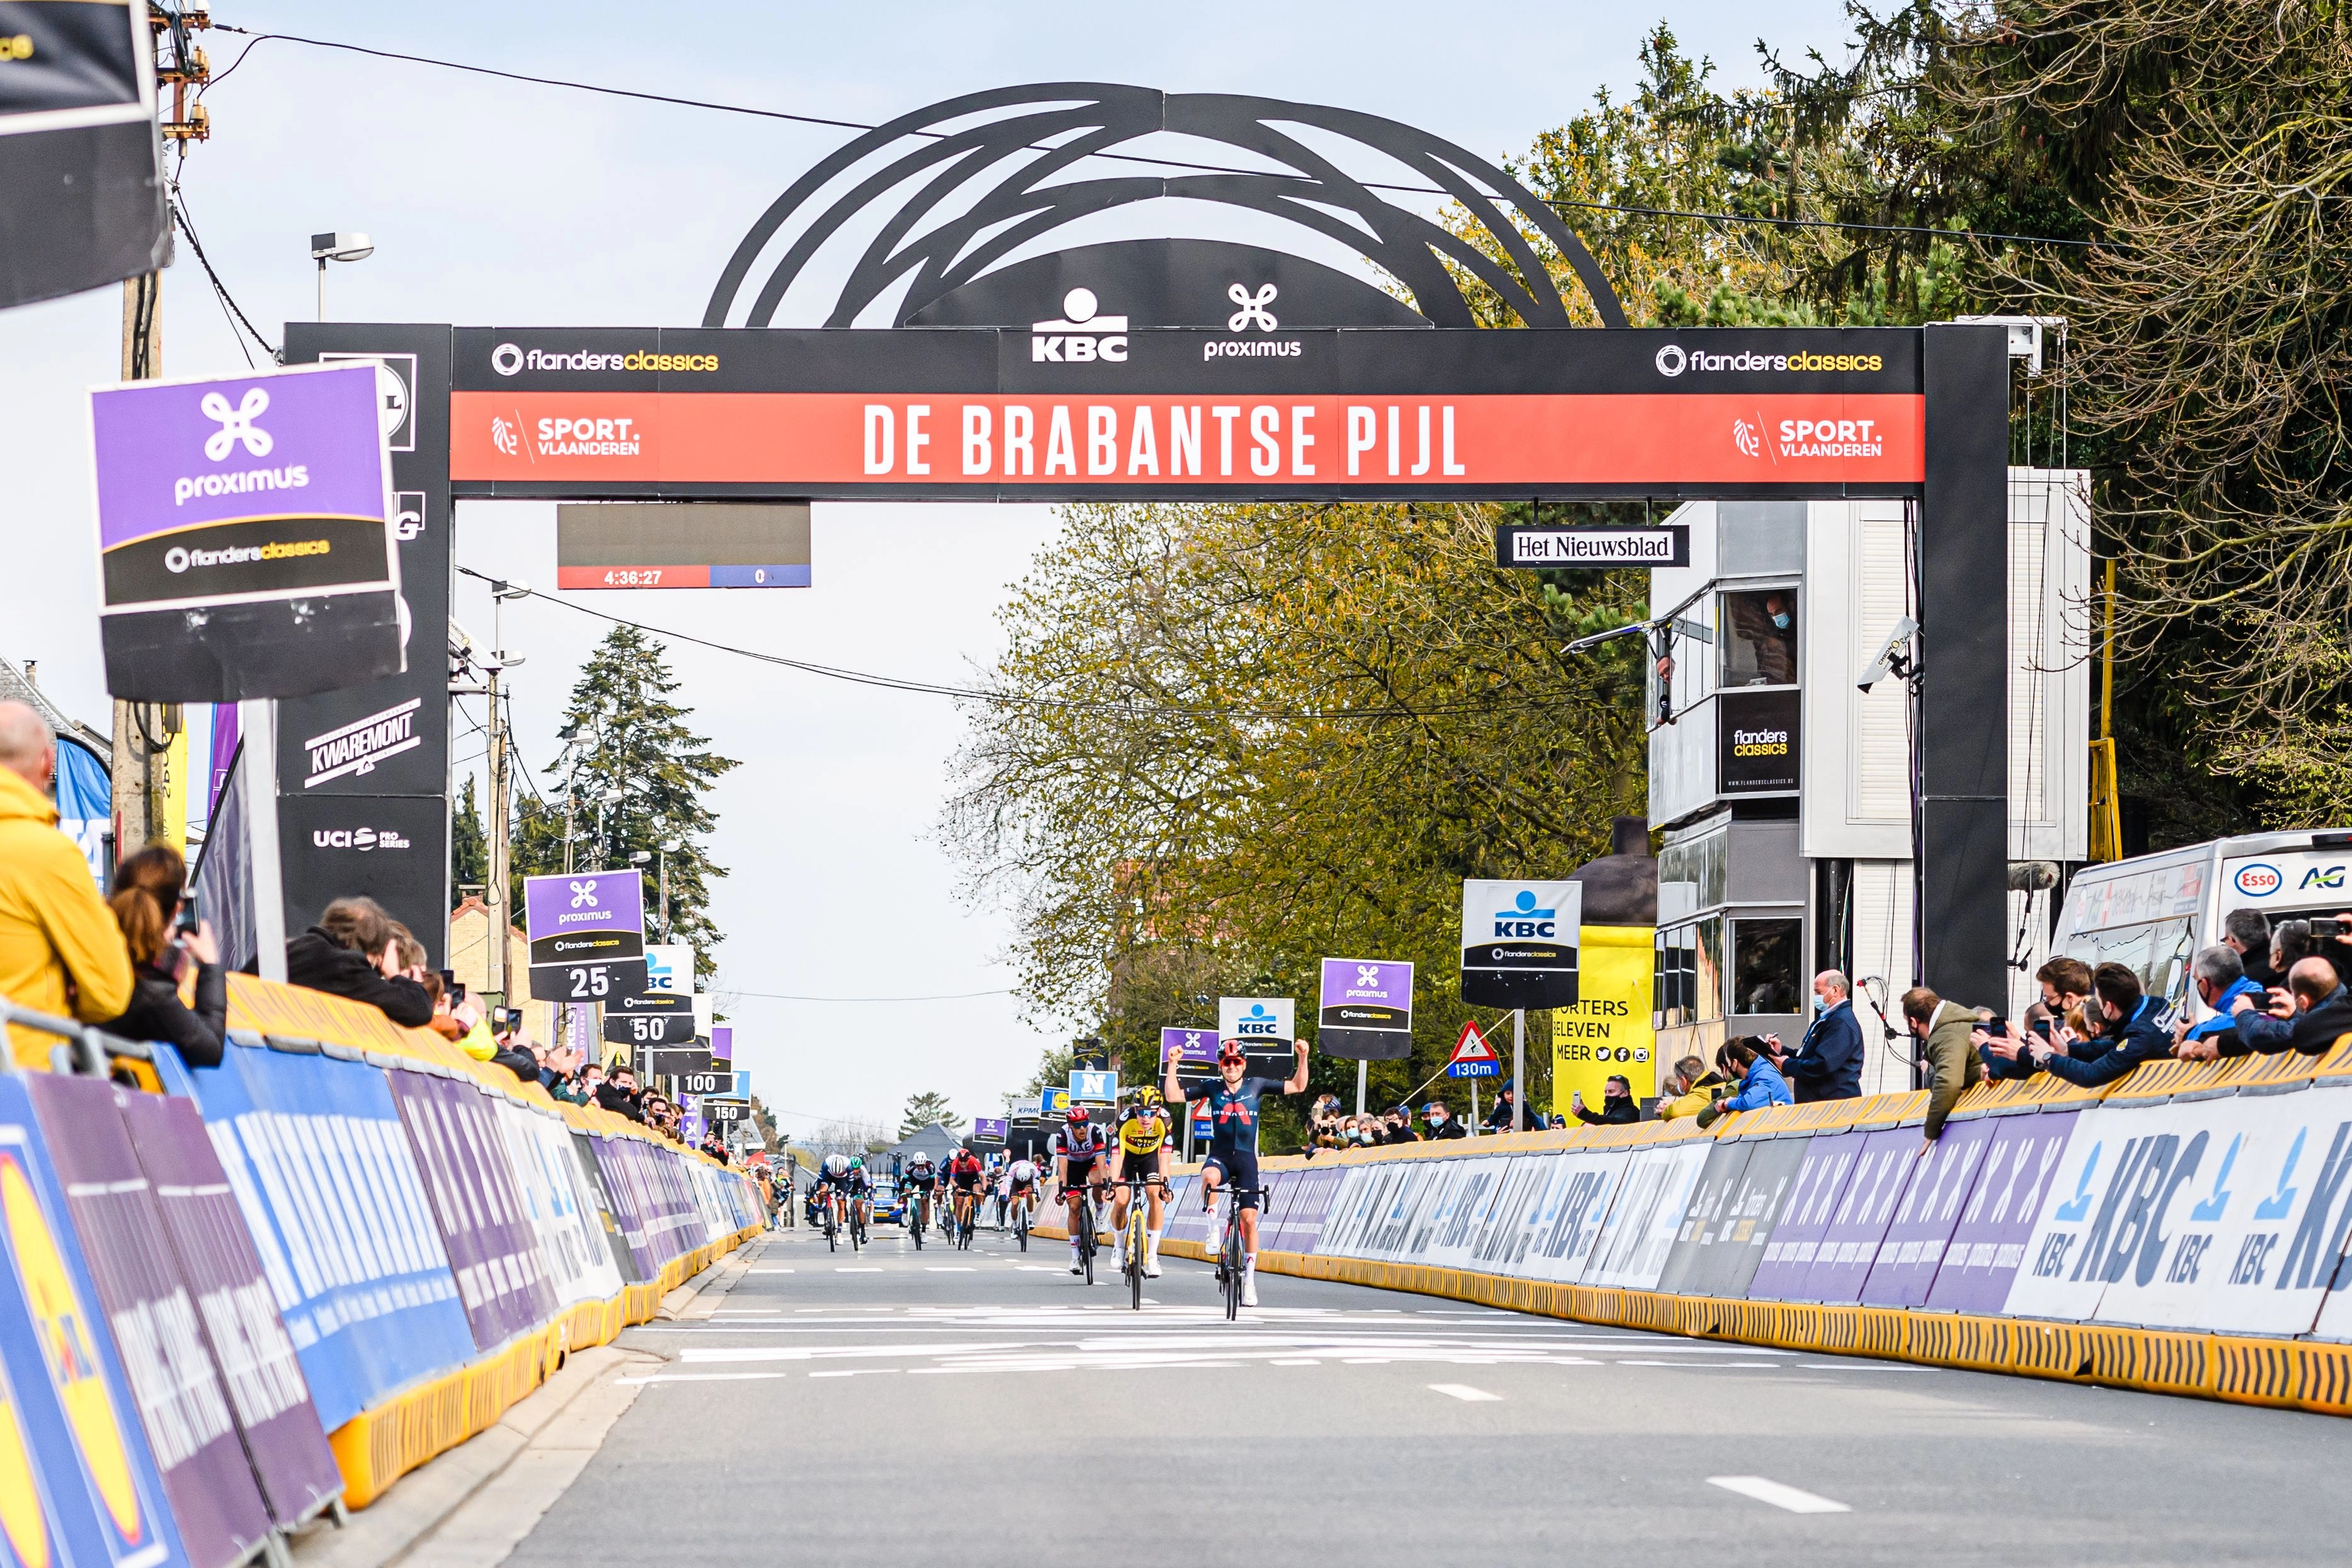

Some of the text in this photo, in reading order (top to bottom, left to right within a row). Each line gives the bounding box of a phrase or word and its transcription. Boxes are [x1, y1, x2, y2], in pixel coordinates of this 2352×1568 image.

[1031, 336, 1128, 362] KBC
[1203, 341, 1302, 362] proximus
[537, 418, 640, 441] SPORT.
[1779, 420, 1883, 442] SPORT.
[864, 404, 1466, 476] DE BRABANTSE PIJL
[537, 442, 640, 456] VLAANDEREN
[1779, 443, 1882, 457] VLAANDEREN
[174, 464, 310, 506] proximus
[1518, 536, 1670, 558] Het Nieuwsblad
[604, 570, 662, 585] 4:36:27
[312, 711, 414, 774] KWAREMONT
[1734, 728, 1787, 745] flanders
[1734, 743, 1787, 757] classics
[313, 830, 352, 847] UCI
[379, 831, 399, 840] PRO
[379, 839, 410, 849] SERIES
[2298, 866, 2346, 890] AG
[558, 910, 612, 925] proximus
[1494, 921, 1555, 938] KBC
[570, 966, 609, 998] 25
[648, 977, 672, 988] BC
[1346, 989, 1388, 999] proximus
[633, 1017, 665, 1041] 50
[1238, 1024, 1276, 1034] KBC
[1557, 1044, 1591, 1061] MEER
[1455, 1062, 1492, 1076] 130m
[685, 1075, 716, 1092] 100
[714, 1106, 738, 1120] 150
[1071, 1142, 1091, 1153] UAE
[2068, 1130, 2210, 1288] KBC
[2032, 1232, 2077, 1278] KBC
[2165, 1233, 2213, 1285] KBC
[2227, 1232, 2280, 1286] KBC
